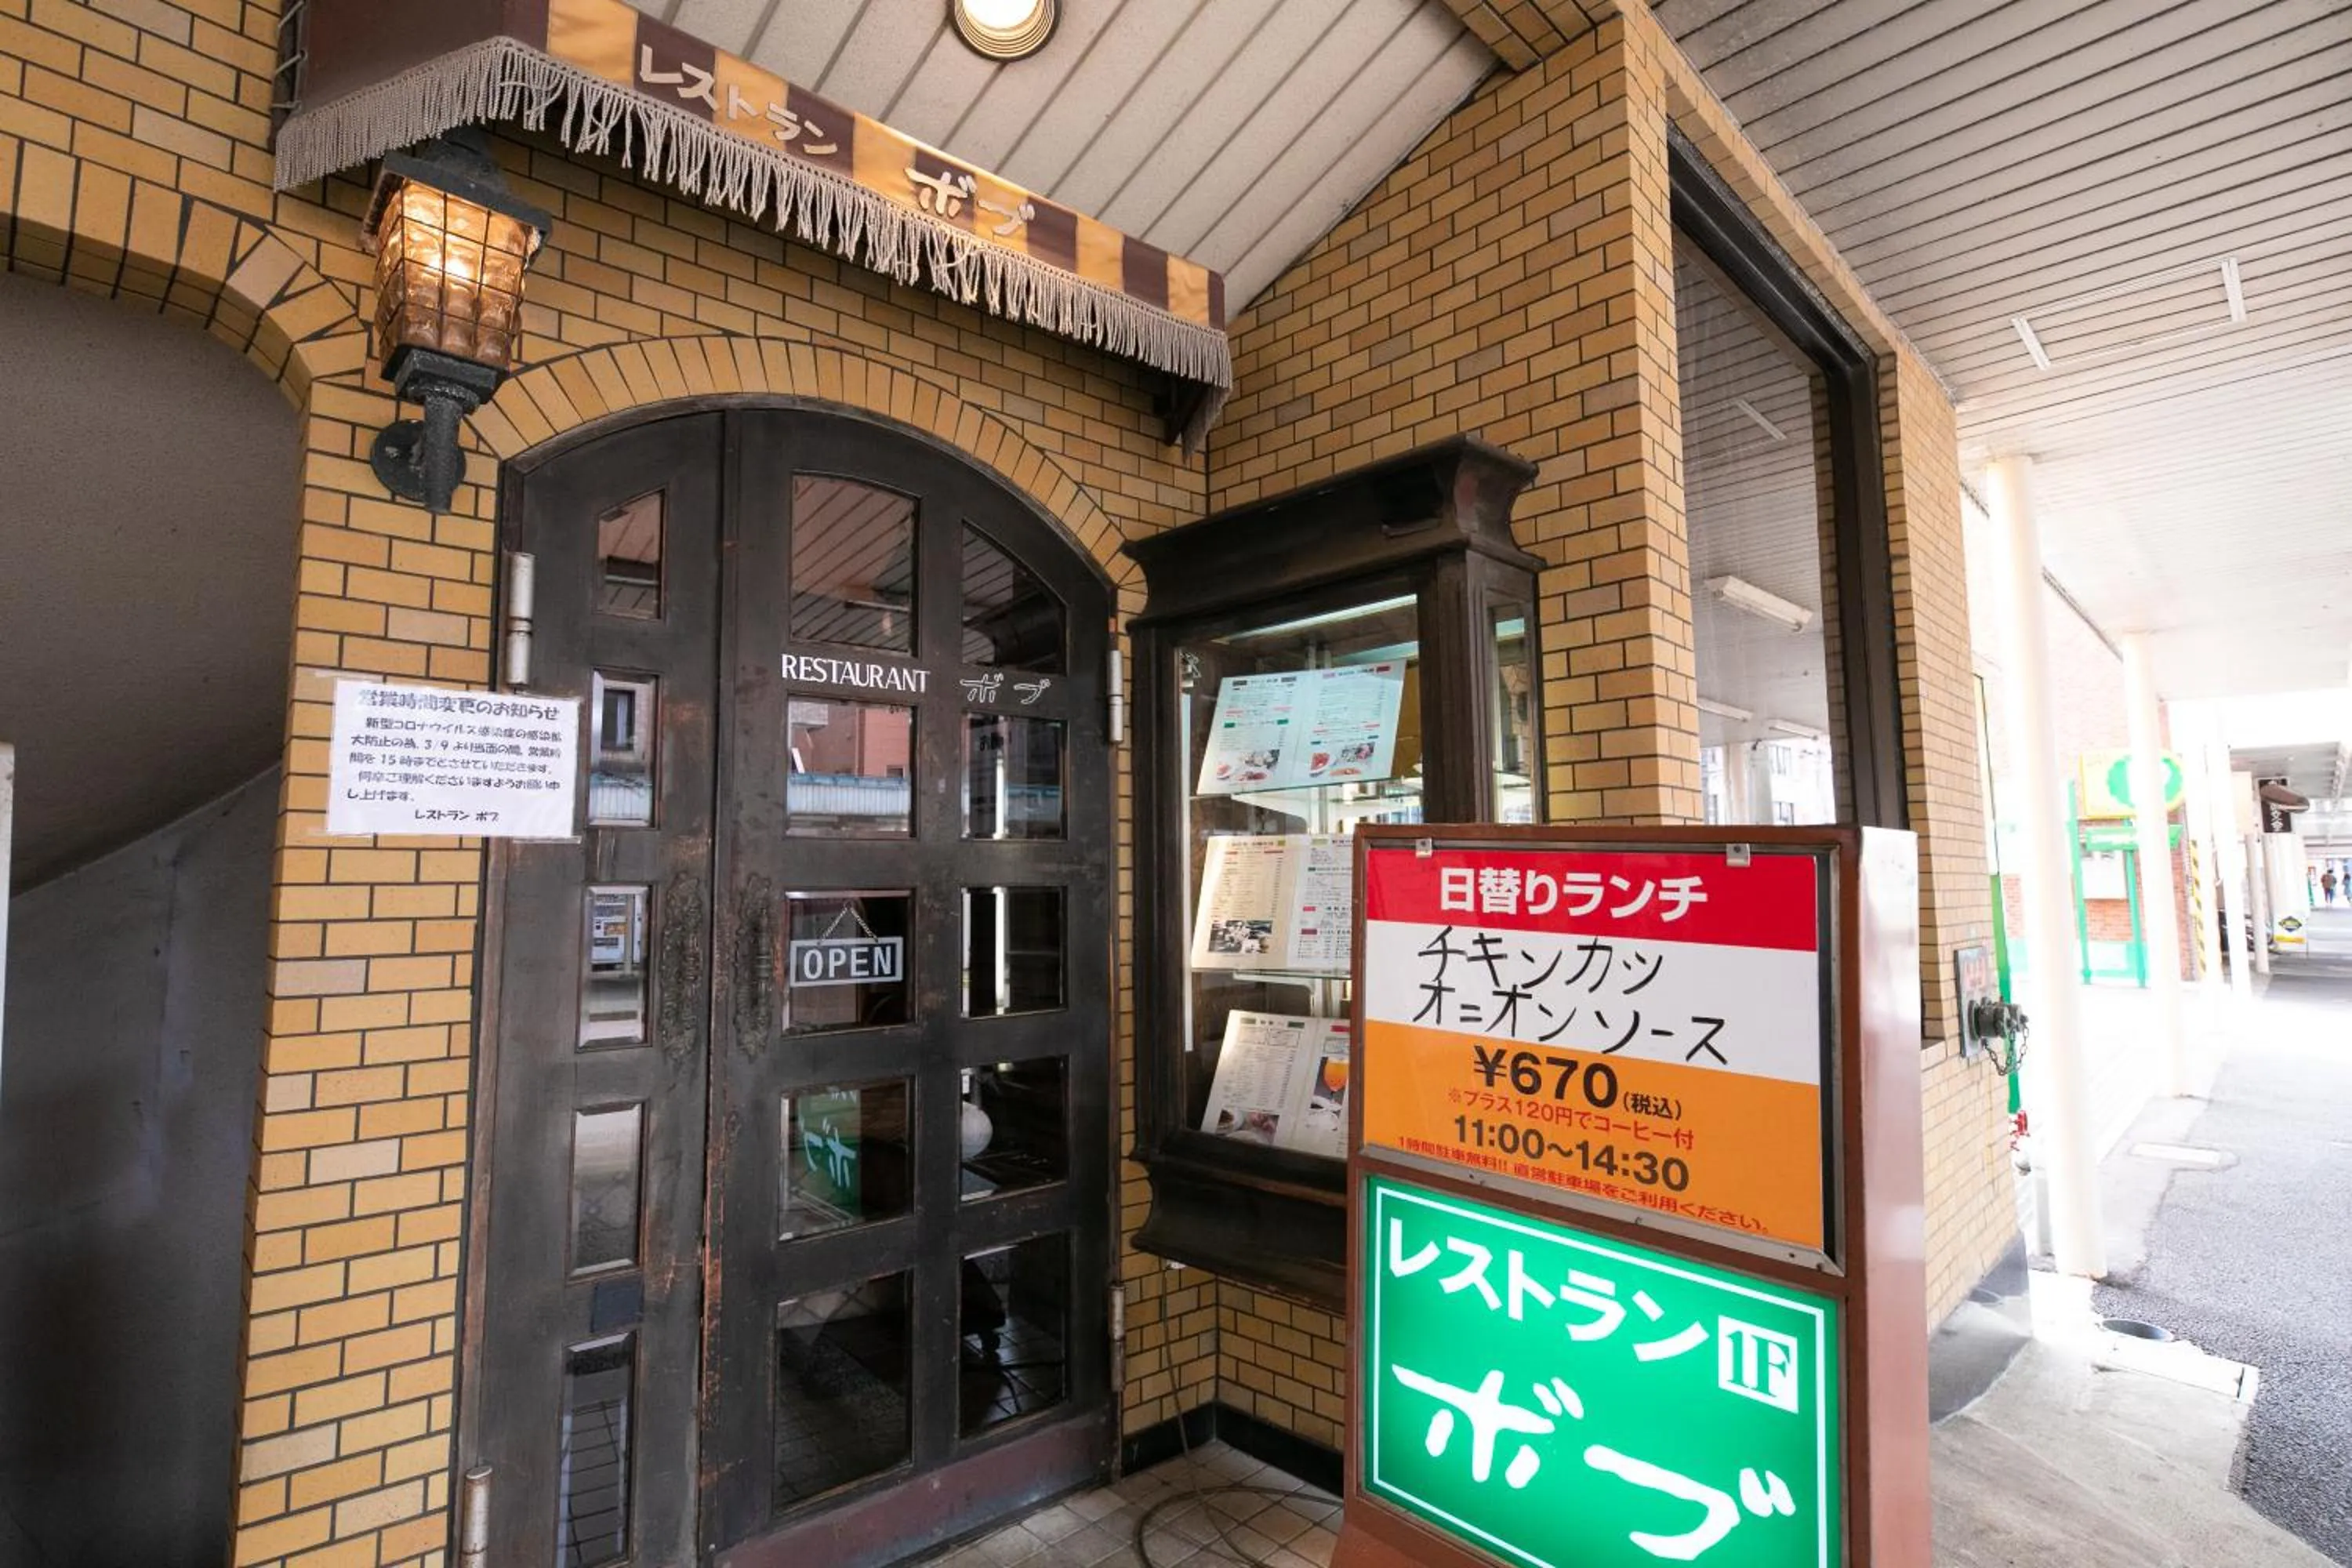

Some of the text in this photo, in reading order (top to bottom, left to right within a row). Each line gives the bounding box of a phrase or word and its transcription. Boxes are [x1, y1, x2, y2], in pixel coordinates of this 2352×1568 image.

[640, 43, 1036, 237] レストラン ボブ
[781, 653, 931, 693] RESTAURANT
[960, 673, 1051, 704] ボブ
[415, 809, 470, 821] レストラン
[1439, 866, 1708, 921] 日替りランチ
[802, 945, 892, 981] OPEN
[1417, 925, 1664, 994] チキンカツ
[1413, 980, 1728, 1065] オニオンソース
[1473, 1045, 1618, 1109] ¥670
[1390, 1217, 1710, 1362] レストラン
[1724, 1328, 1791, 1399] 1F
[1391, 1364, 1796, 1562] ボブ
